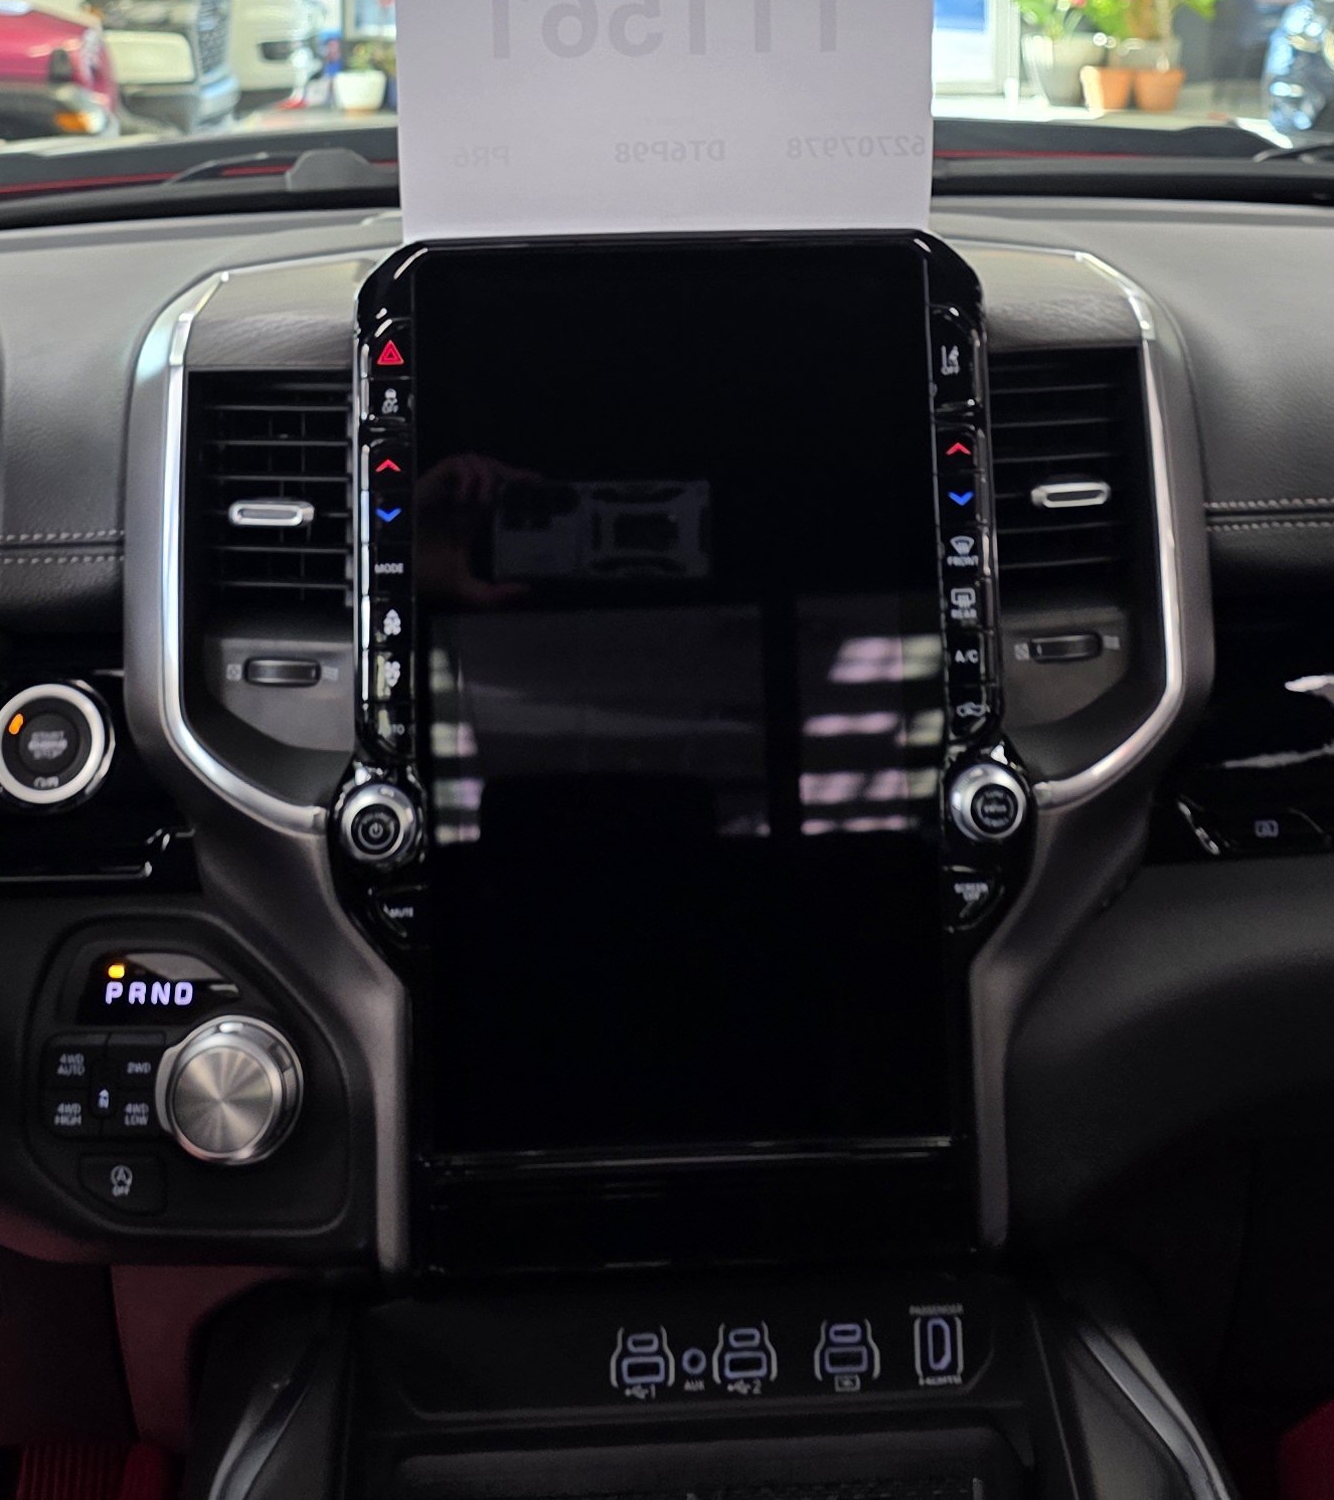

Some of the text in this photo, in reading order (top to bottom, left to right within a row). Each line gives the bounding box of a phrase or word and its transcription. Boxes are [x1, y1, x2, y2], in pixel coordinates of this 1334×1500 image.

[374, 562, 404, 574] MODE
[954, 649, 979, 664] A/C
[59, 1053, 85, 1064] 4WD
[56, 1064, 86, 1076] AUTO
[126, 1062, 152, 1074] 2WD
[124, 1115, 149, 1127] LOW
